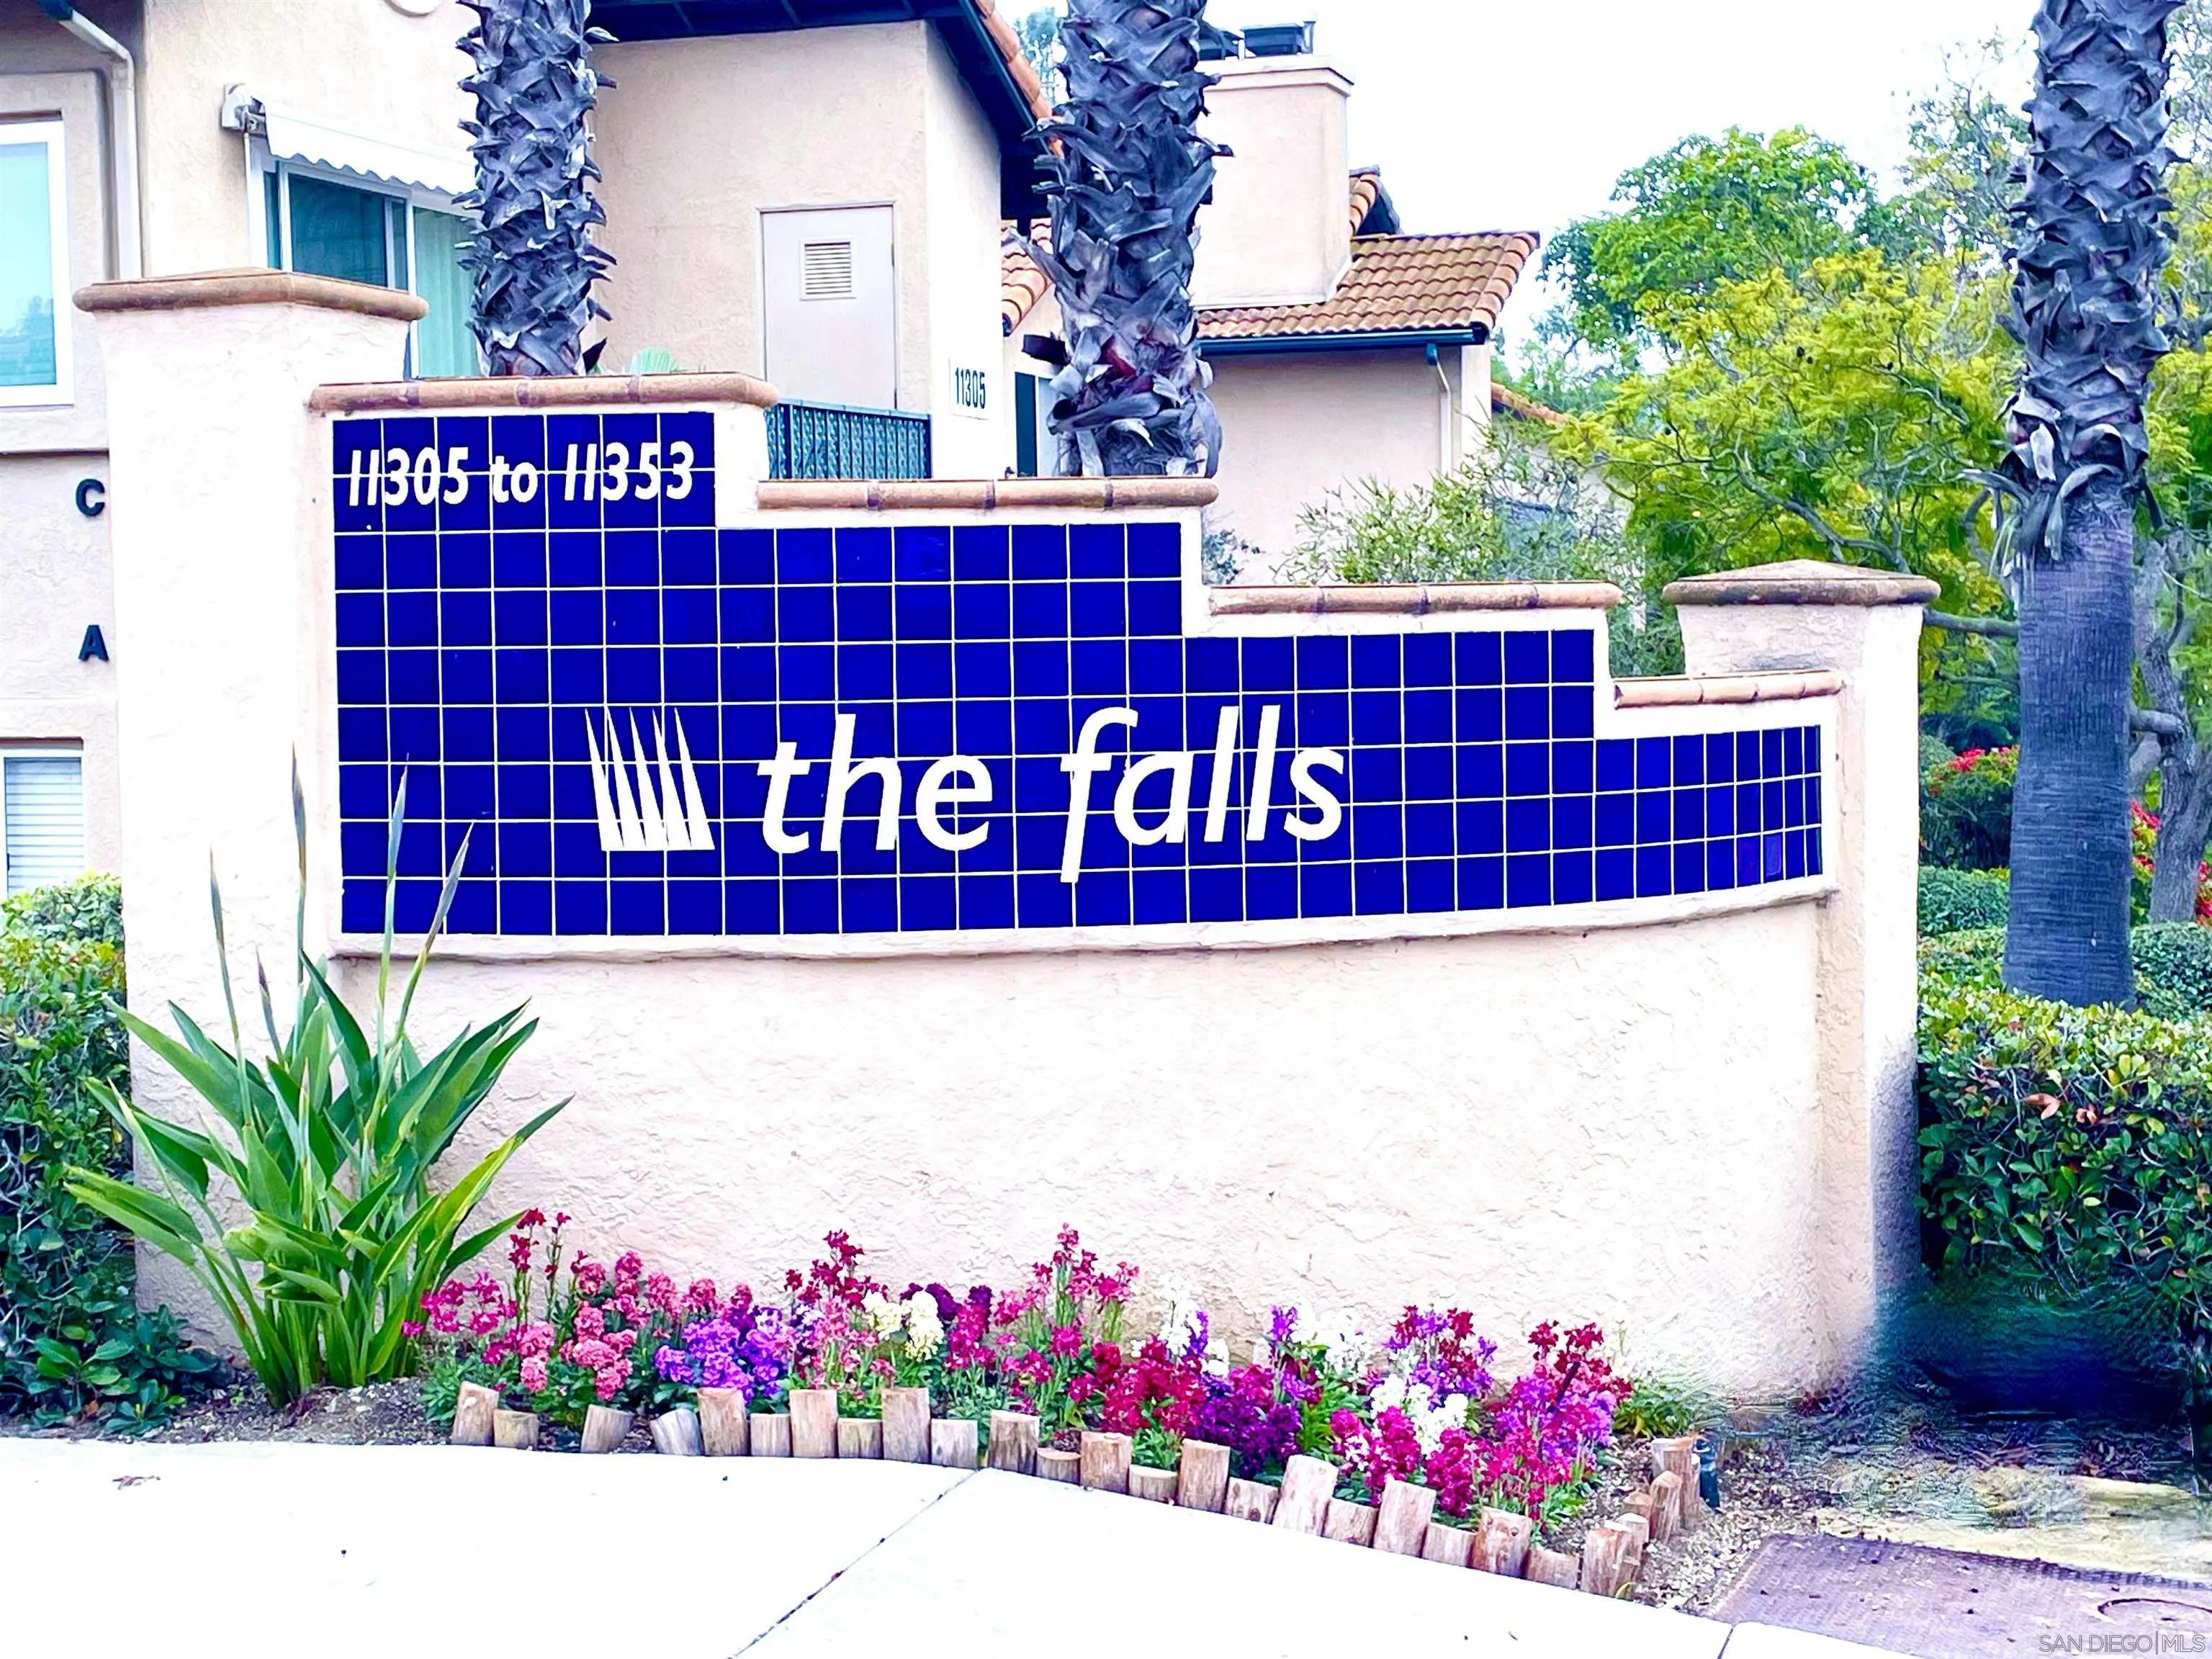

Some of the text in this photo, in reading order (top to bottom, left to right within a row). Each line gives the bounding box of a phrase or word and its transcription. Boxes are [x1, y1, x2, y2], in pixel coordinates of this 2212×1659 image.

[955, 367, 986, 410] 11305
[349, 441, 694, 506] 11305 to 11353
[76, 478, 105, 518] C
[78, 624, 109, 662] A
[757, 704, 1345, 884] the falls
